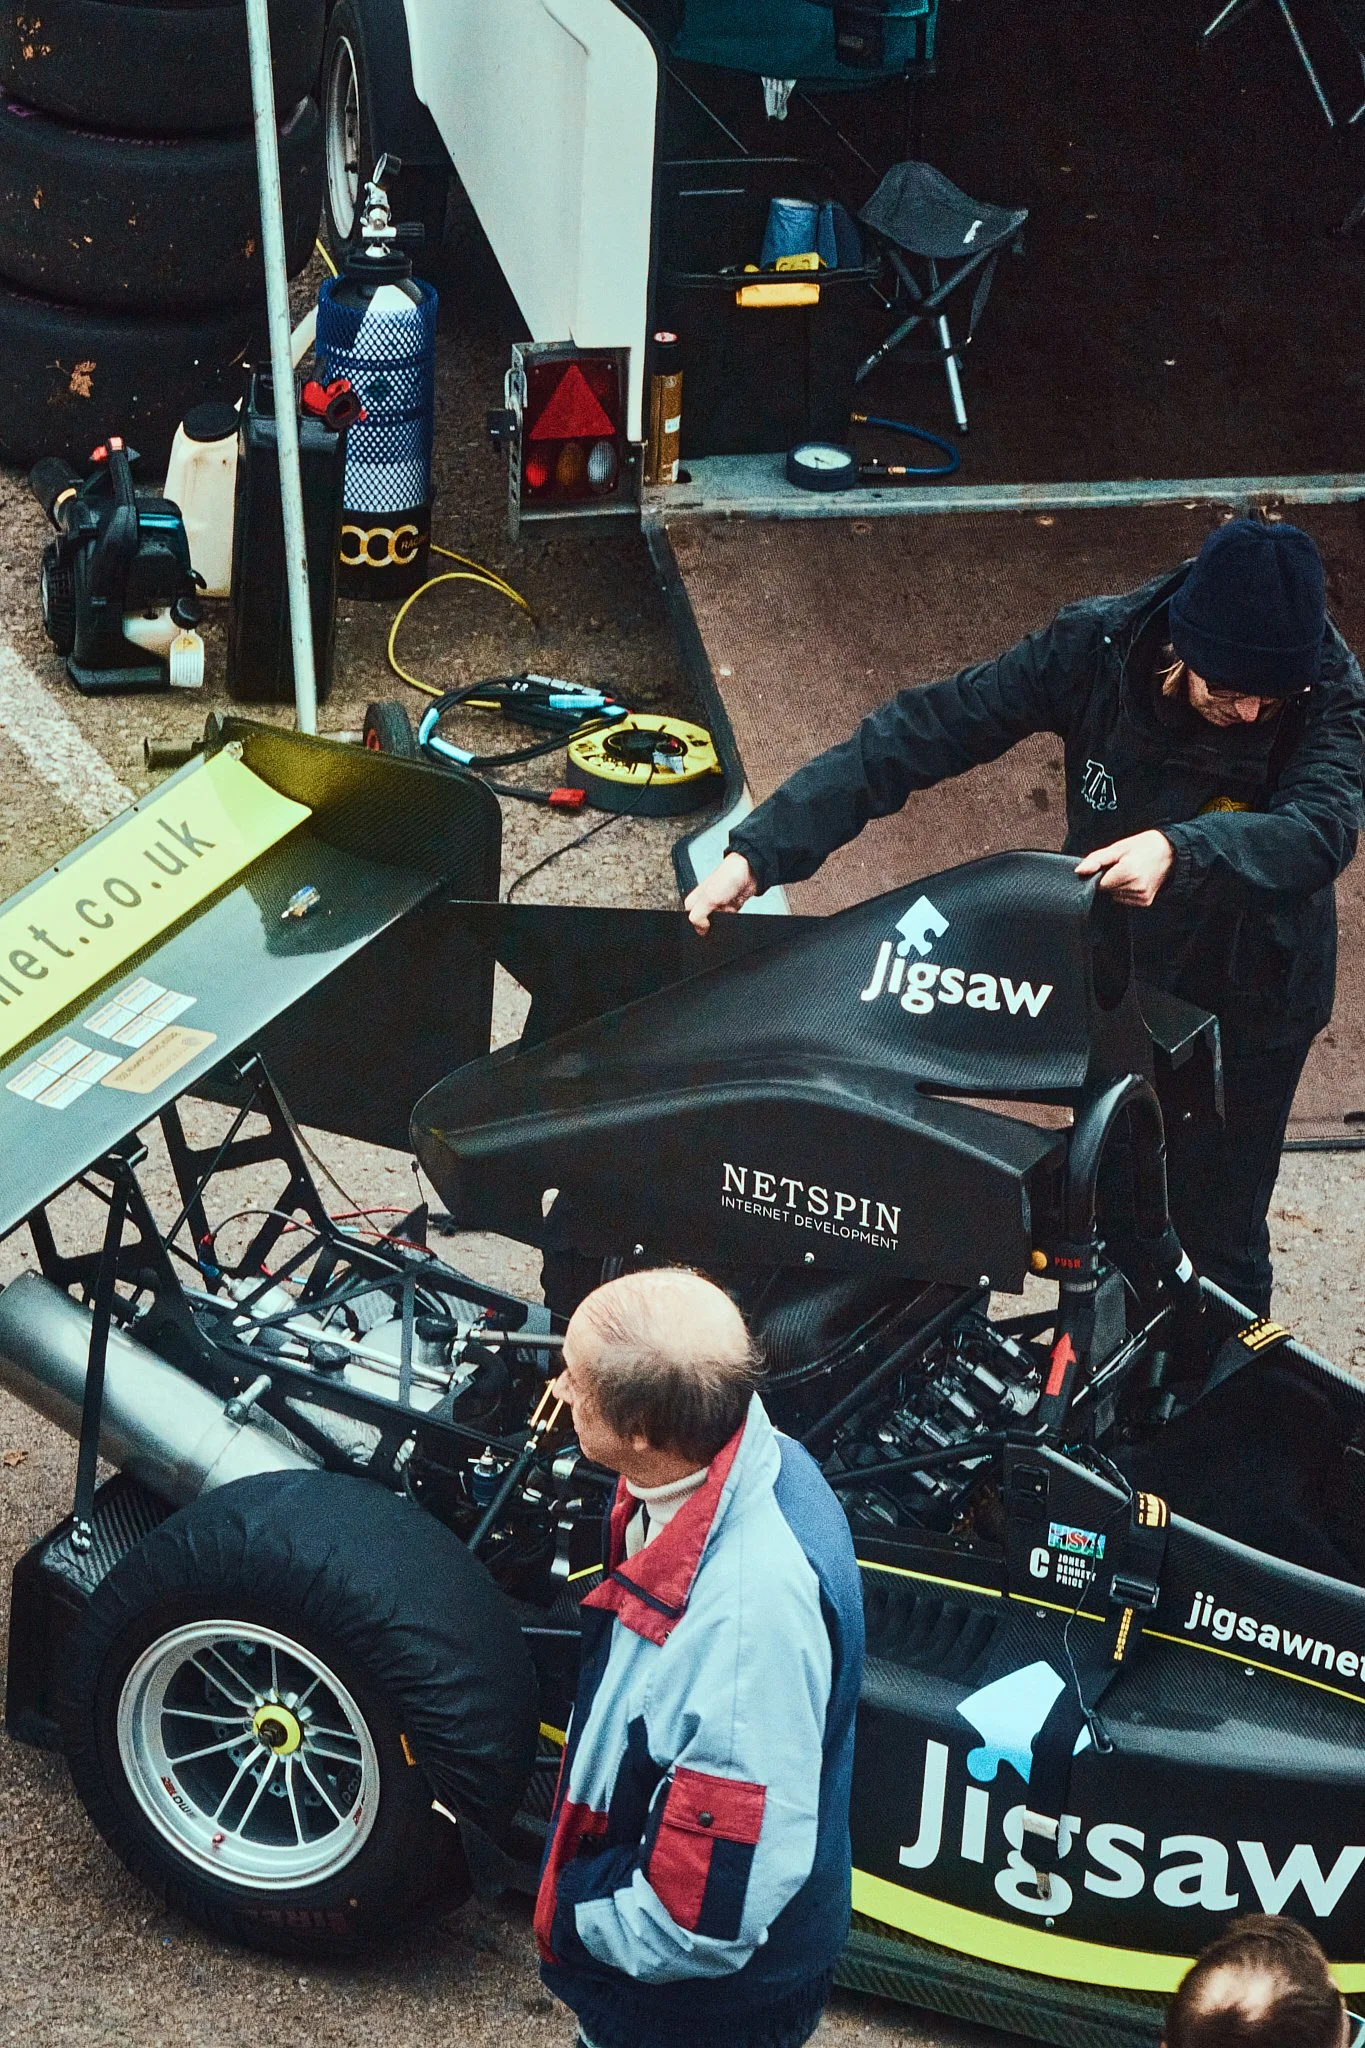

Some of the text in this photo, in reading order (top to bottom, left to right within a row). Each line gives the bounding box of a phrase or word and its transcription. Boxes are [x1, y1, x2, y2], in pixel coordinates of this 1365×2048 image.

[722, 1162, 901, 1235] NETSPIN
[721, 1195, 899, 1251] INTERNET DEVELOPMENT
[1058, 1553, 1086, 1568] JONES
[1055, 1573, 1083, 1589] PRICE
